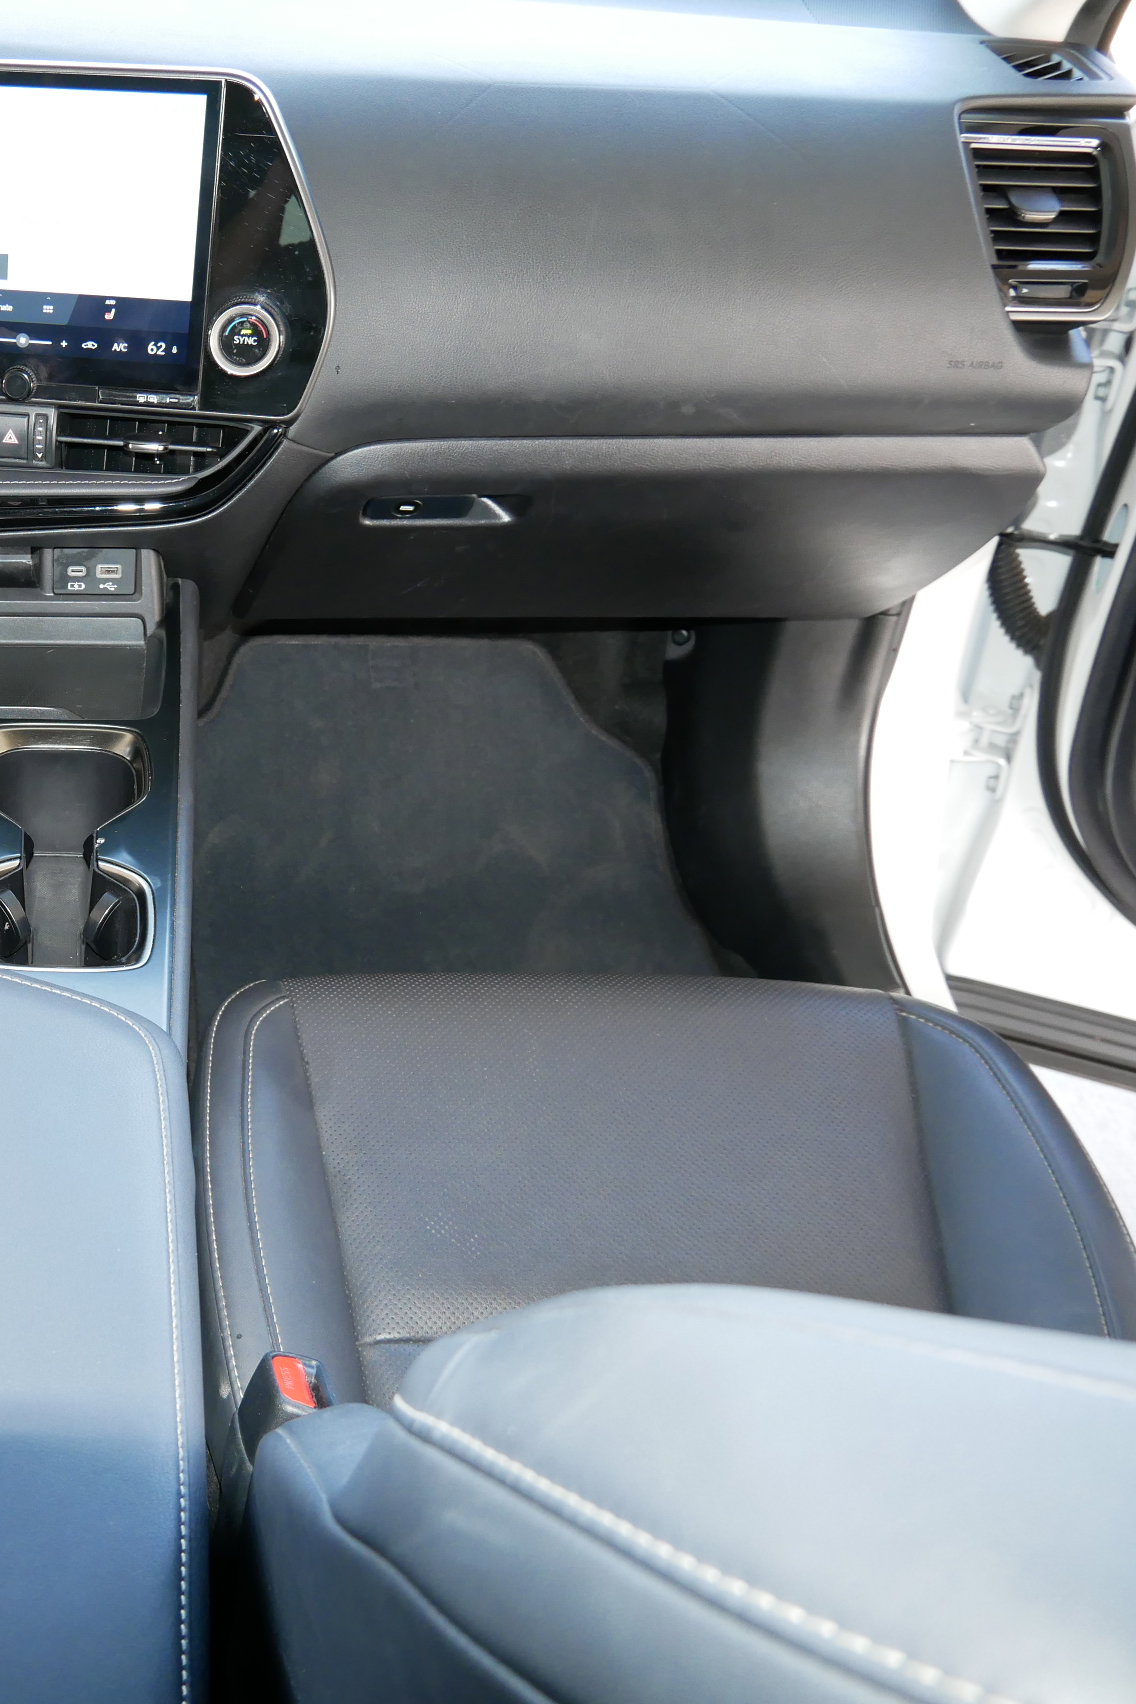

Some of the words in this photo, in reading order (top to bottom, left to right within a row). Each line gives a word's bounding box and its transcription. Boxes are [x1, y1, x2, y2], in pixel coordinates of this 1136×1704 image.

[233, 335, 258, 345] SYNC
[111, 342, 128, 352] A/C
[147, 341, 166, 356] 62
